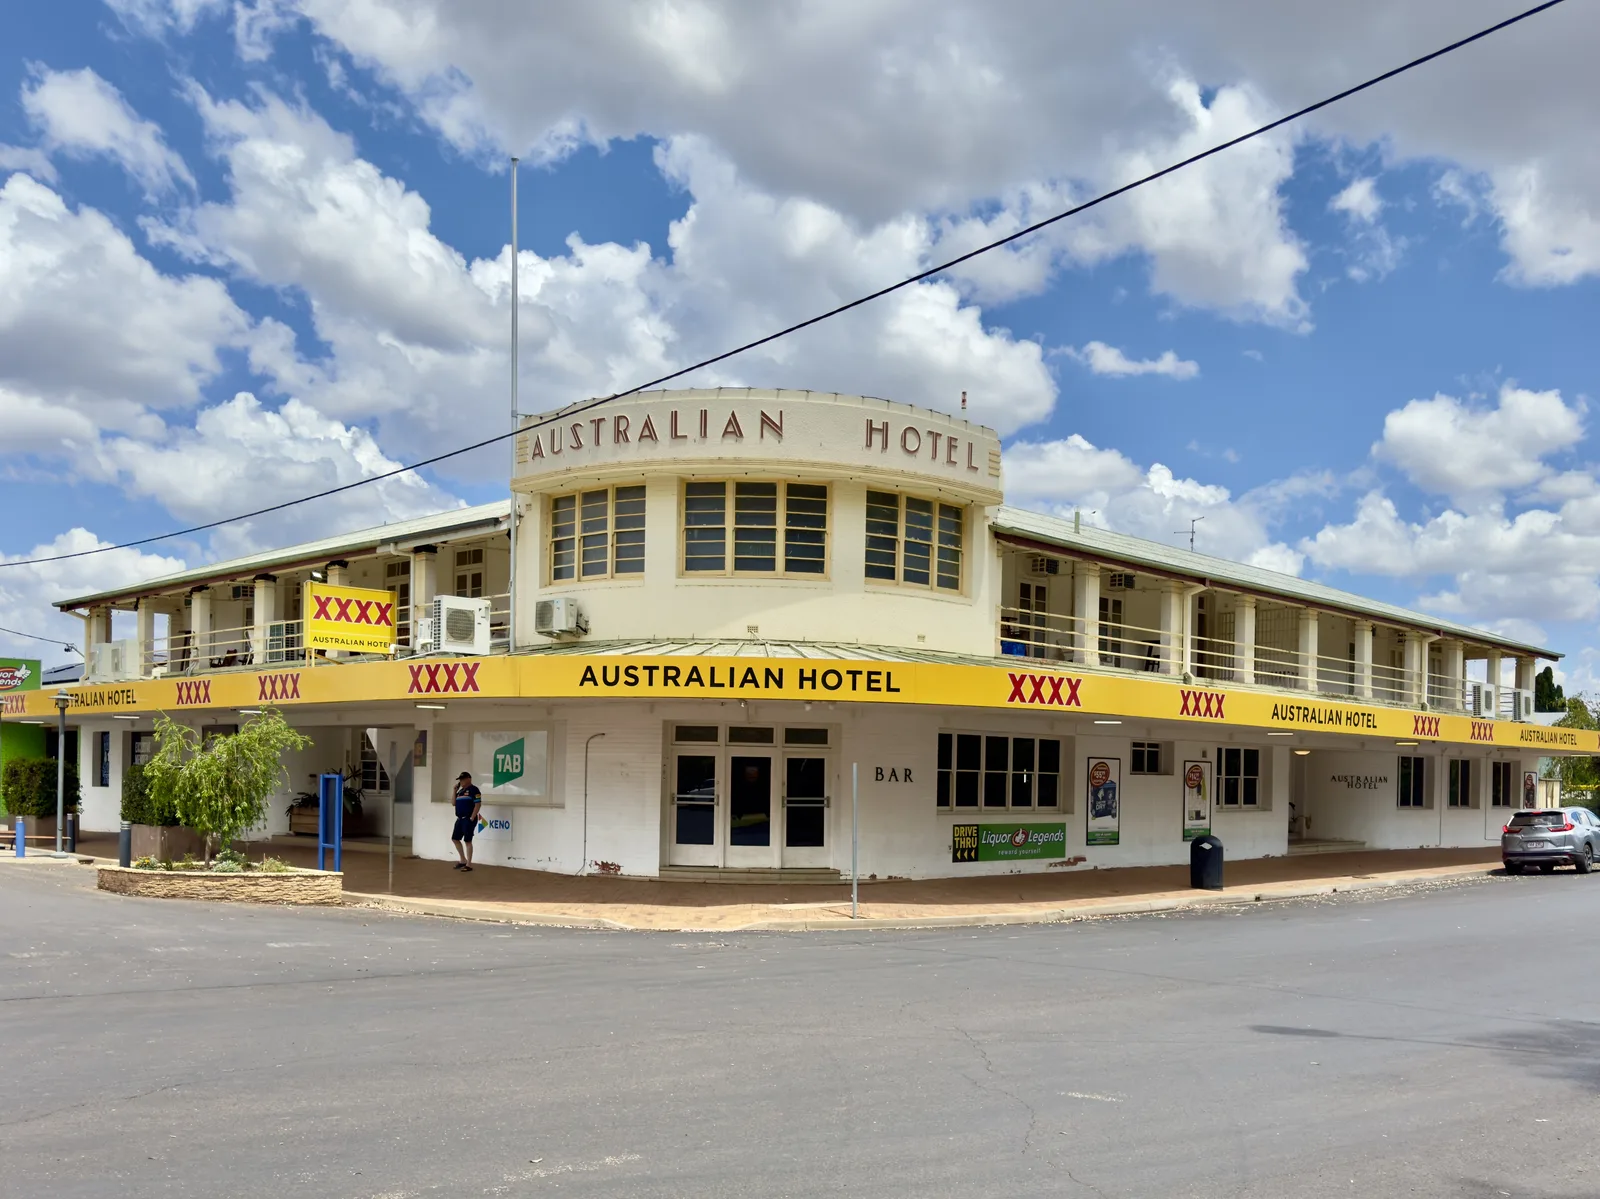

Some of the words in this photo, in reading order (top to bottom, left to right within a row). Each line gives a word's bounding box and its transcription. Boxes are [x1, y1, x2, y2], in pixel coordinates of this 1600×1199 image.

[532, 409, 784, 460] AUSTRALIAN
[865, 418, 978, 470] HOTEL
[313, 595, 393, 627] XXXX
[313, 636, 365, 646] AUSTRALIAN
[54, 692, 104, 708] STRALIAN
[107, 689, 136, 704] HOTEL
[176, 680, 212, 705] XXXX
[258, 673, 300, 701] XXXX
[408, 663, 481, 694] XXXX
[579, 664, 783, 688] AUSTRALIAN
[798, 668, 901, 692] HOTEL
[1007, 672, 1082, 707] XXXX
[1179, 689, 1226, 719] XXXX
[1271, 703, 1342, 725] AUSTRALIAN
[1345, 711, 1377, 729] HOTEL
[1413, 715, 1441, 737] XXXX
[1470, 721, 1494, 741] XXXX
[1520, 729, 1558, 743] AUSTRALIAN
[1559, 733, 1577, 745] HOTEL
[496, 754, 521, 772] TAB
[875, 766, 914, 783] BAR
[1331, 774, 1388, 784] AUSTRALIAN
[1347, 781, 1378, 790] HOTEL
[489, 819, 510, 829] KENO
[954, 826, 978, 837] DRIVE
[981, 830, 1012, 847] Liquor
[1027, 830, 1064, 845] Legends
[954, 837, 978, 849] THRU
[1019, 848, 1041, 856] yourself
